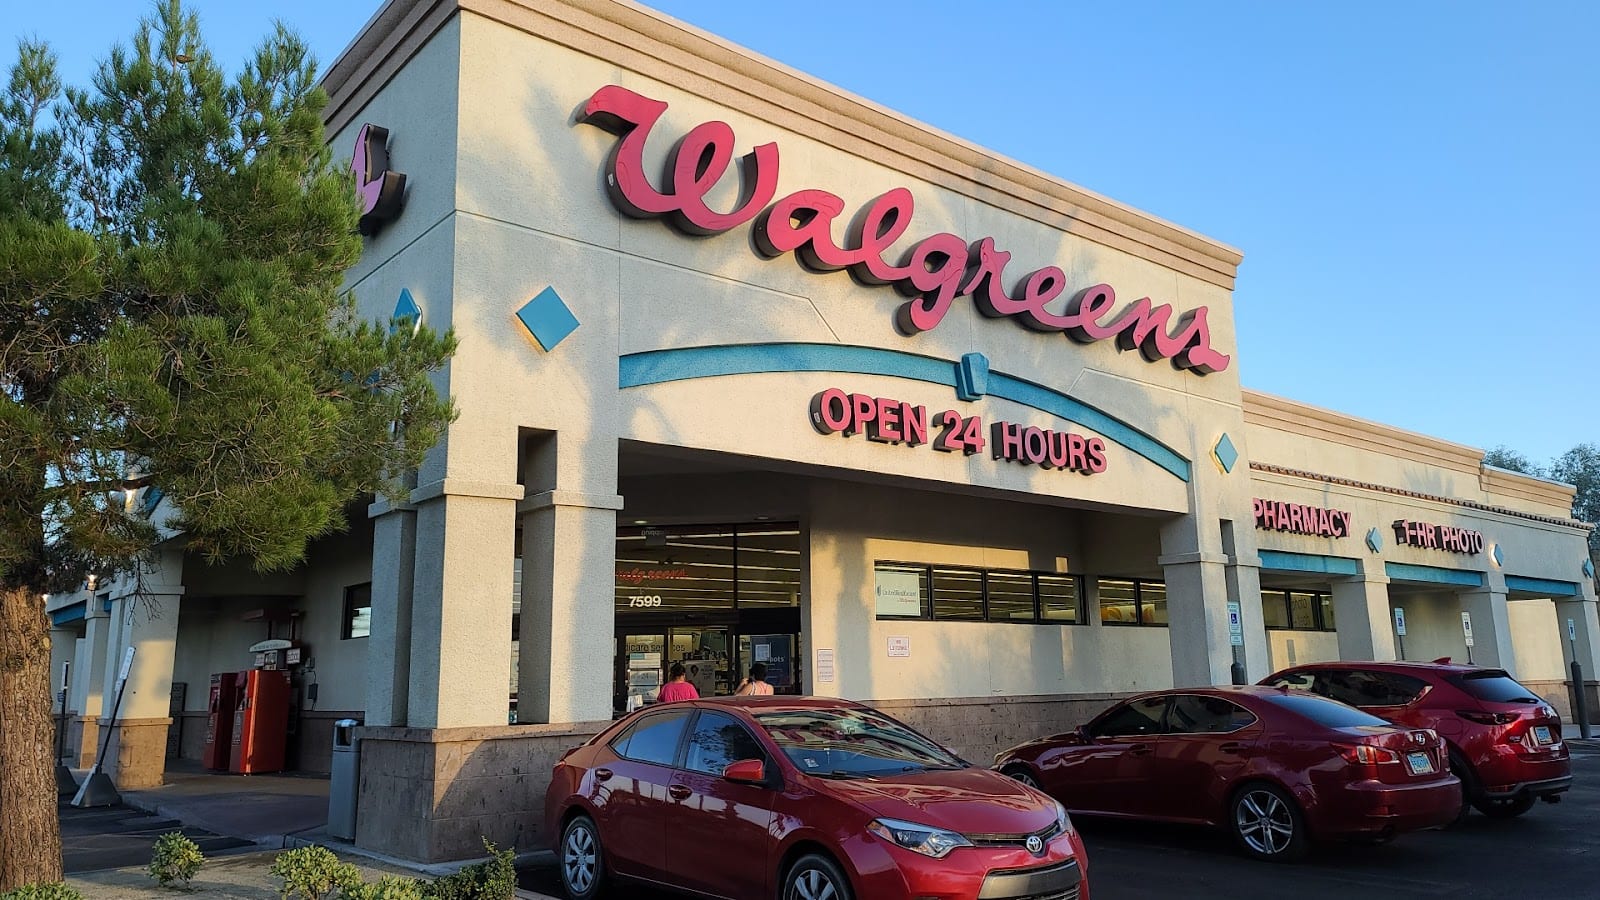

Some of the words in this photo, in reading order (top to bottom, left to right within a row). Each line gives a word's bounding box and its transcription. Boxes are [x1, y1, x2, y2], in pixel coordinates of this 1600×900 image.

[582, 85, 1230, 373] Walgreens
[815, 388, 928, 445] OPEN
[938, 410, 986, 454] 24
[997, 421, 1108, 474] HOURS
[1253, 497, 1351, 539] PHARMACY
[1398, 518, 1437, 549] 1-HR
[1440, 525, 1485, 554] PHOTO
[628, 595, 662, 608] 7599
